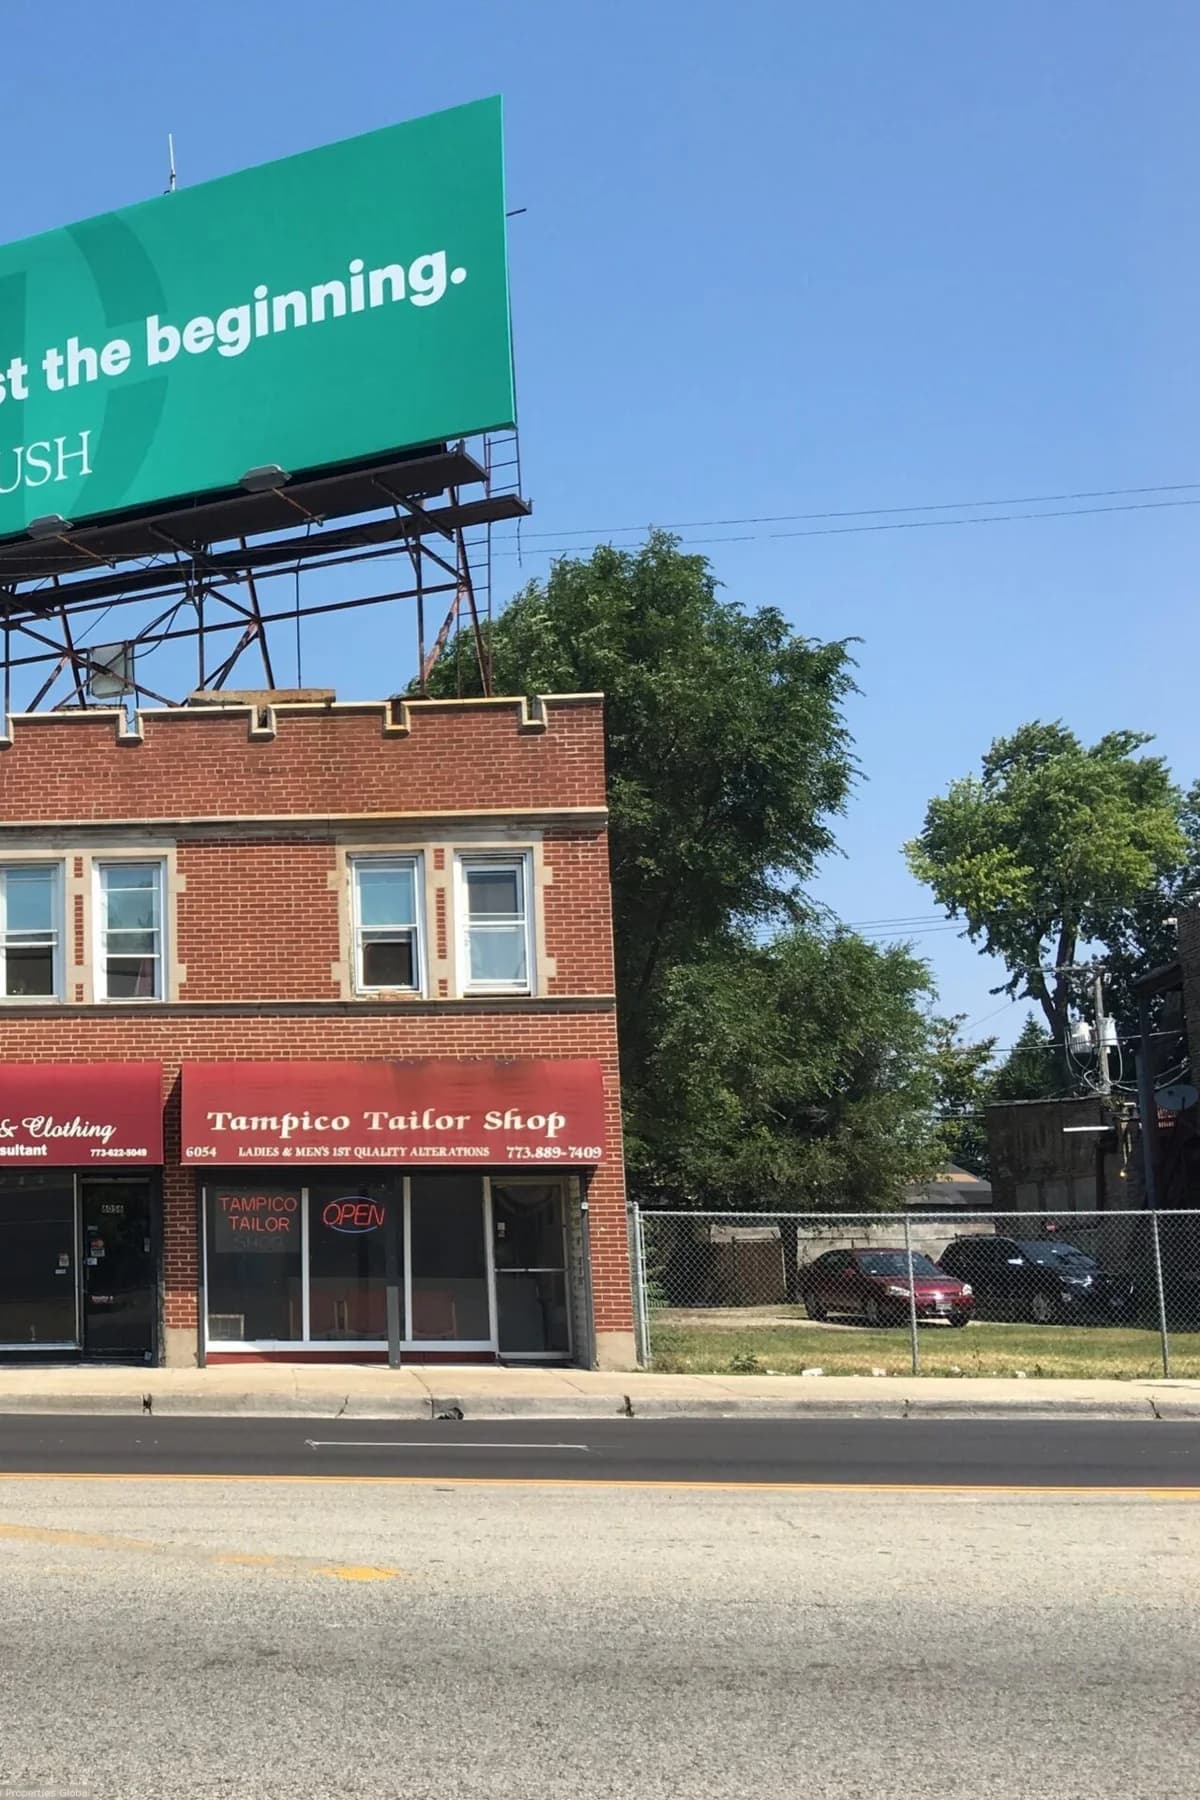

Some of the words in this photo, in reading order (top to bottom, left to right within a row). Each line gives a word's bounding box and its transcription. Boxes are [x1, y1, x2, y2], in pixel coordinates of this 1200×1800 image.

[42, 337, 131, 392] the
[146, 250, 467, 366] beginning.
[21, 1115, 117, 1145] Clothing
[206, 1110, 350, 1139] Tampico
[362, 1107, 471, 1131] Tailor
[483, 1107, 566, 1138] Shop
[185, 1146, 217, 1158] 6054
[238, 1146, 280, 1158] LADIES
[281, 1146, 293, 1158] &
[295, 1146, 330, 1158] MEN'S
[332, 1146, 351, 1158] 1ST
[353, 1146, 409, 1159] QUALITY
[409, 1146, 491, 1158] ALTERATIONS
[506, 1146, 602, 1159] 773.889-7409
[218, 1196, 298, 1212] TAMPICO
[228, 1215, 291, 1232] TAILOR
[322, 1203, 386, 1227] OPEN
